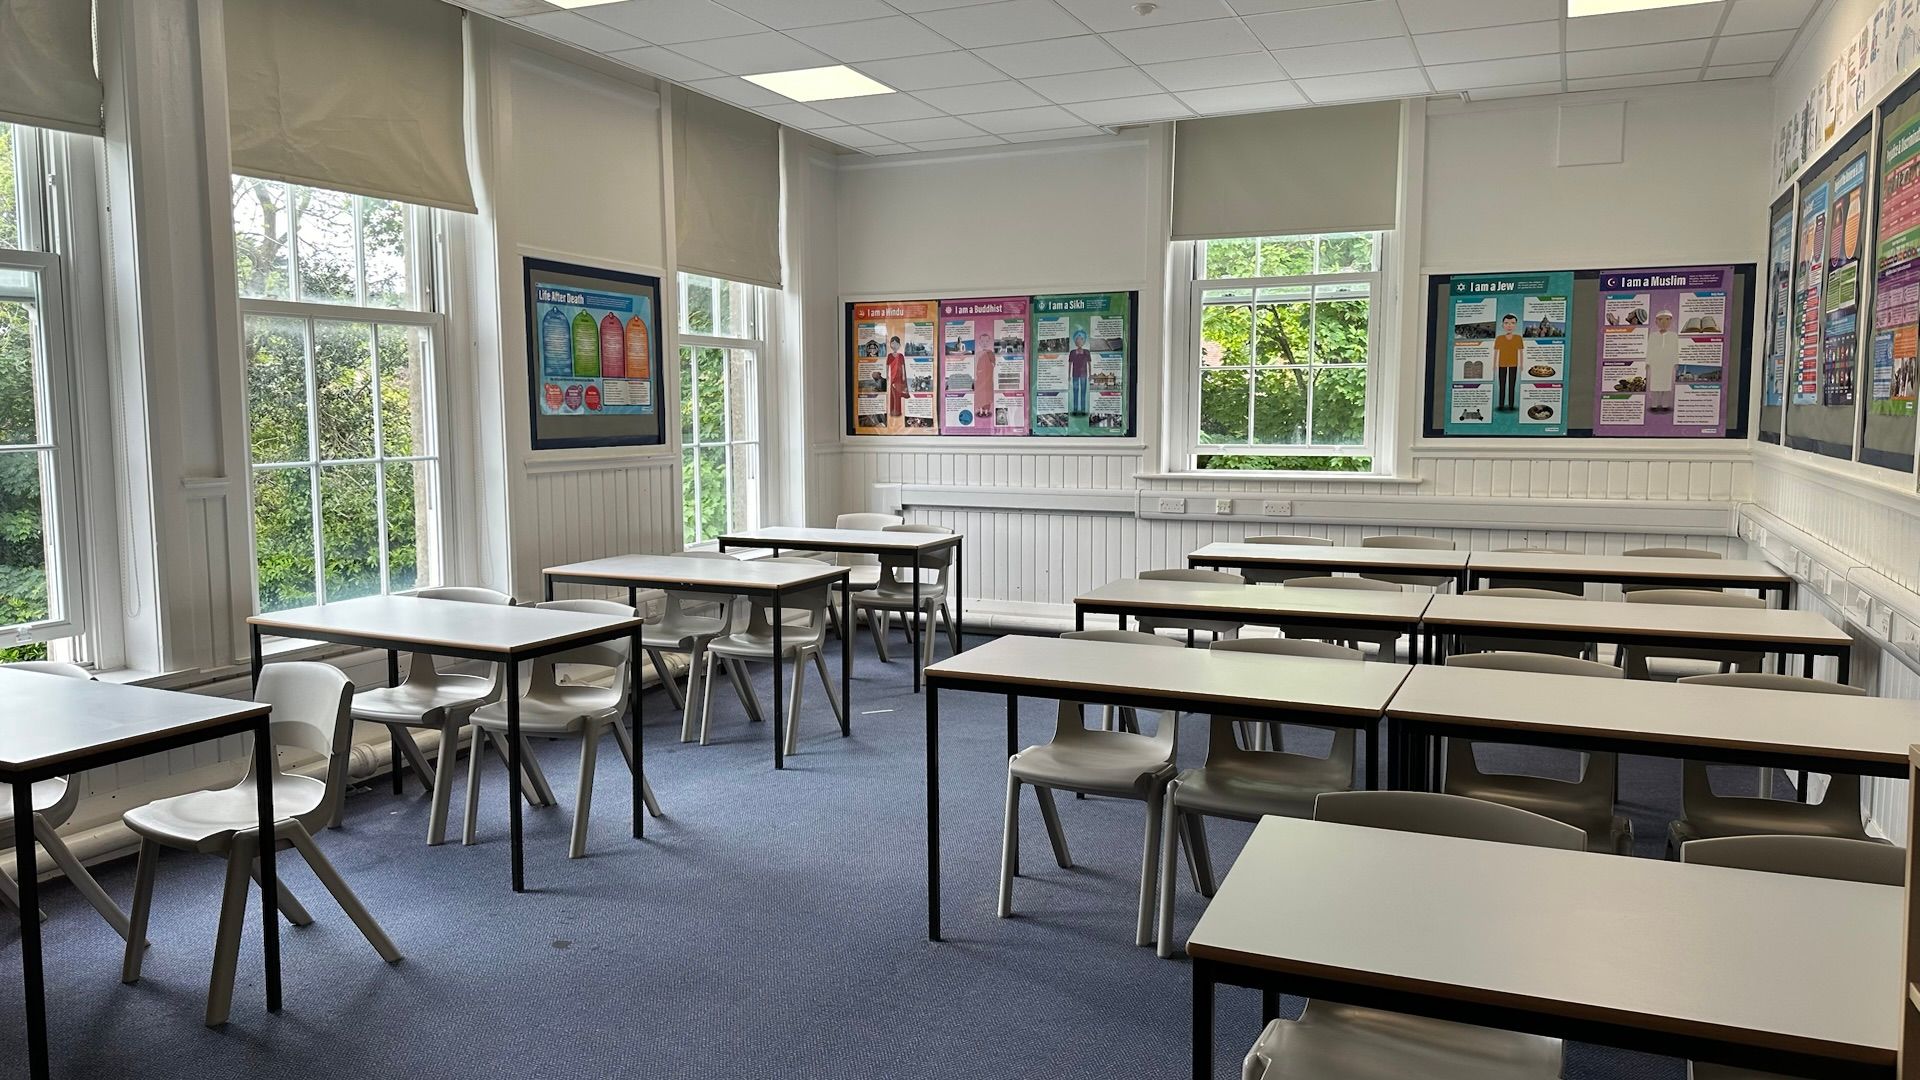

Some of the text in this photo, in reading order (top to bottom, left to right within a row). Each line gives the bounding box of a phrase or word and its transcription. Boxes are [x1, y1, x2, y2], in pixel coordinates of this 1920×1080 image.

[1470, 282, 1474, 292] I
[1475, 283, 1489, 292] am
[1490, 283, 1496, 292] a
[1497, 281, 1515, 291] Jew
[1621, 277, 1626, 288] I
[1627, 279, 1642, 287] am
[1643, 278, 1649, 287] a
[1651, 275, 1686, 287] Muslim
[539, 290, 551, 302] Life
[551, 291, 566, 303] After
[567, 293, 585, 305] Death
[958, 307, 969, 315] am
[974, 304, 1003, 314] Buddhist
[1052, 302, 1063, 310] am
[1069, 300, 1085, 310] Sikh
[886, 307, 904, 317] Hindu
